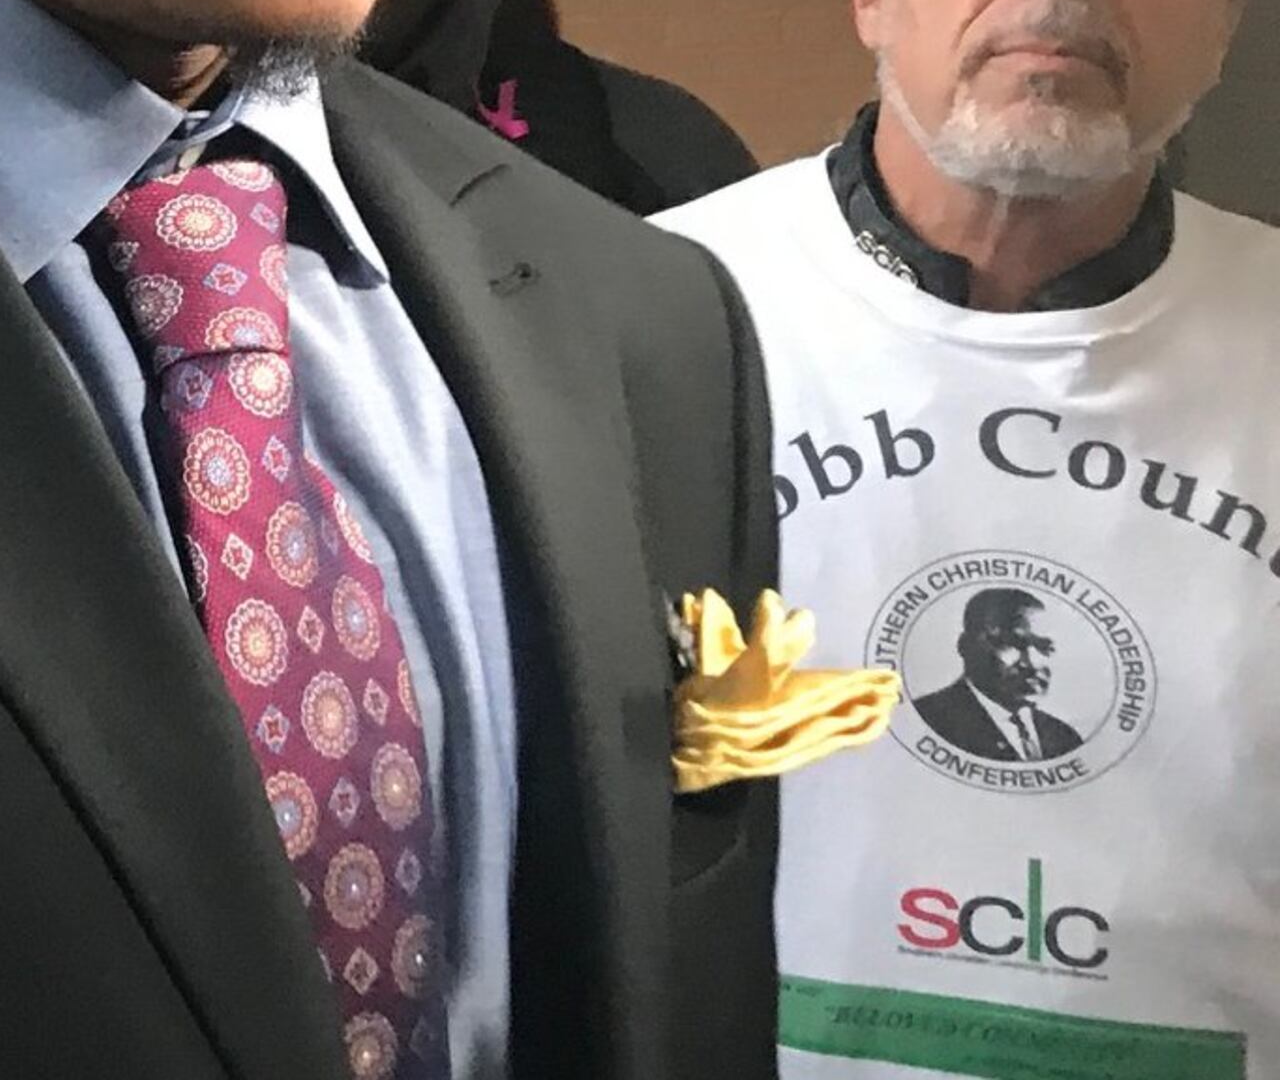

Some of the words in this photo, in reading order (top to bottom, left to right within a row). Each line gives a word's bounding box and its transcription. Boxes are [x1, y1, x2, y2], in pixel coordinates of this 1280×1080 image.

[927, 558, 1075, 595] CHRISTIAN
[1075, 588, 1146, 733] LEADERSHIP
[915, 734, 1090, 788] CONFERENCE
[897, 858, 1110, 970] sclc
